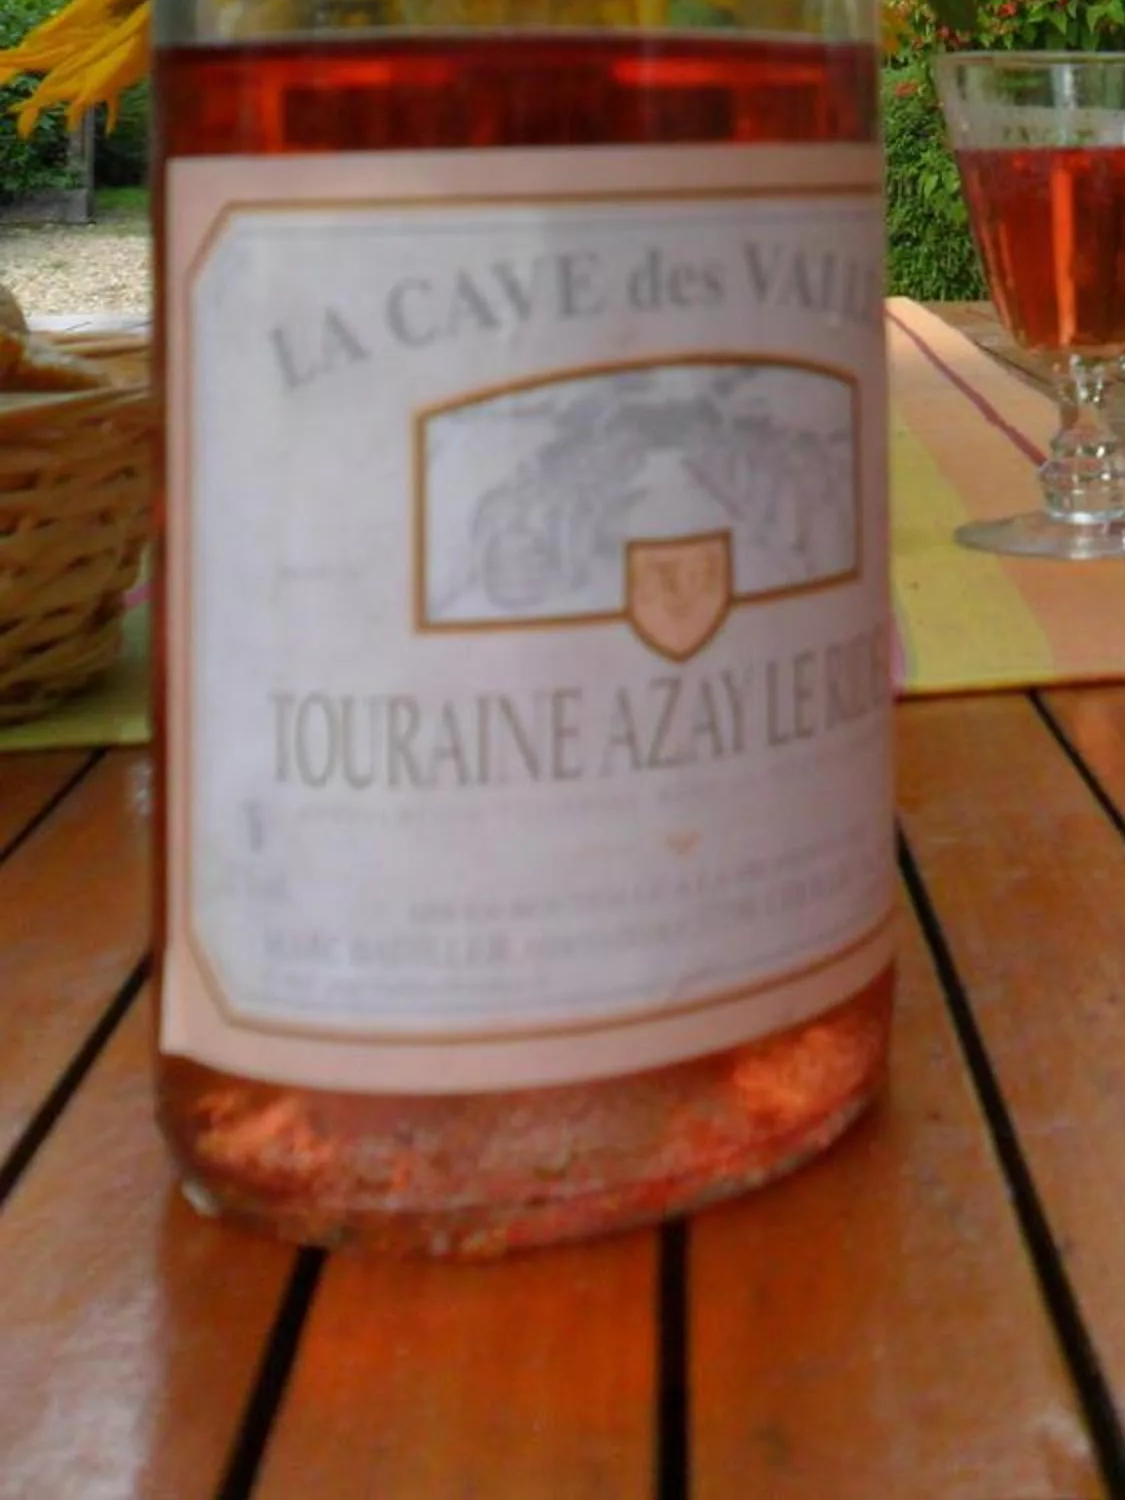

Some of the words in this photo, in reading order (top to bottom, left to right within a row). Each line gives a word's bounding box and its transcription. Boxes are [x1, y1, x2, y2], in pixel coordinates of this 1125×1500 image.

[267, 306, 370, 392] LA
[384, 248, 602, 350] CAVE
[625, 247, 723, 310] des
[267, 686, 584, 790] TOURAINE
[602, 668, 752, 774] AZAY
[765, 648, 816, 748] LE
